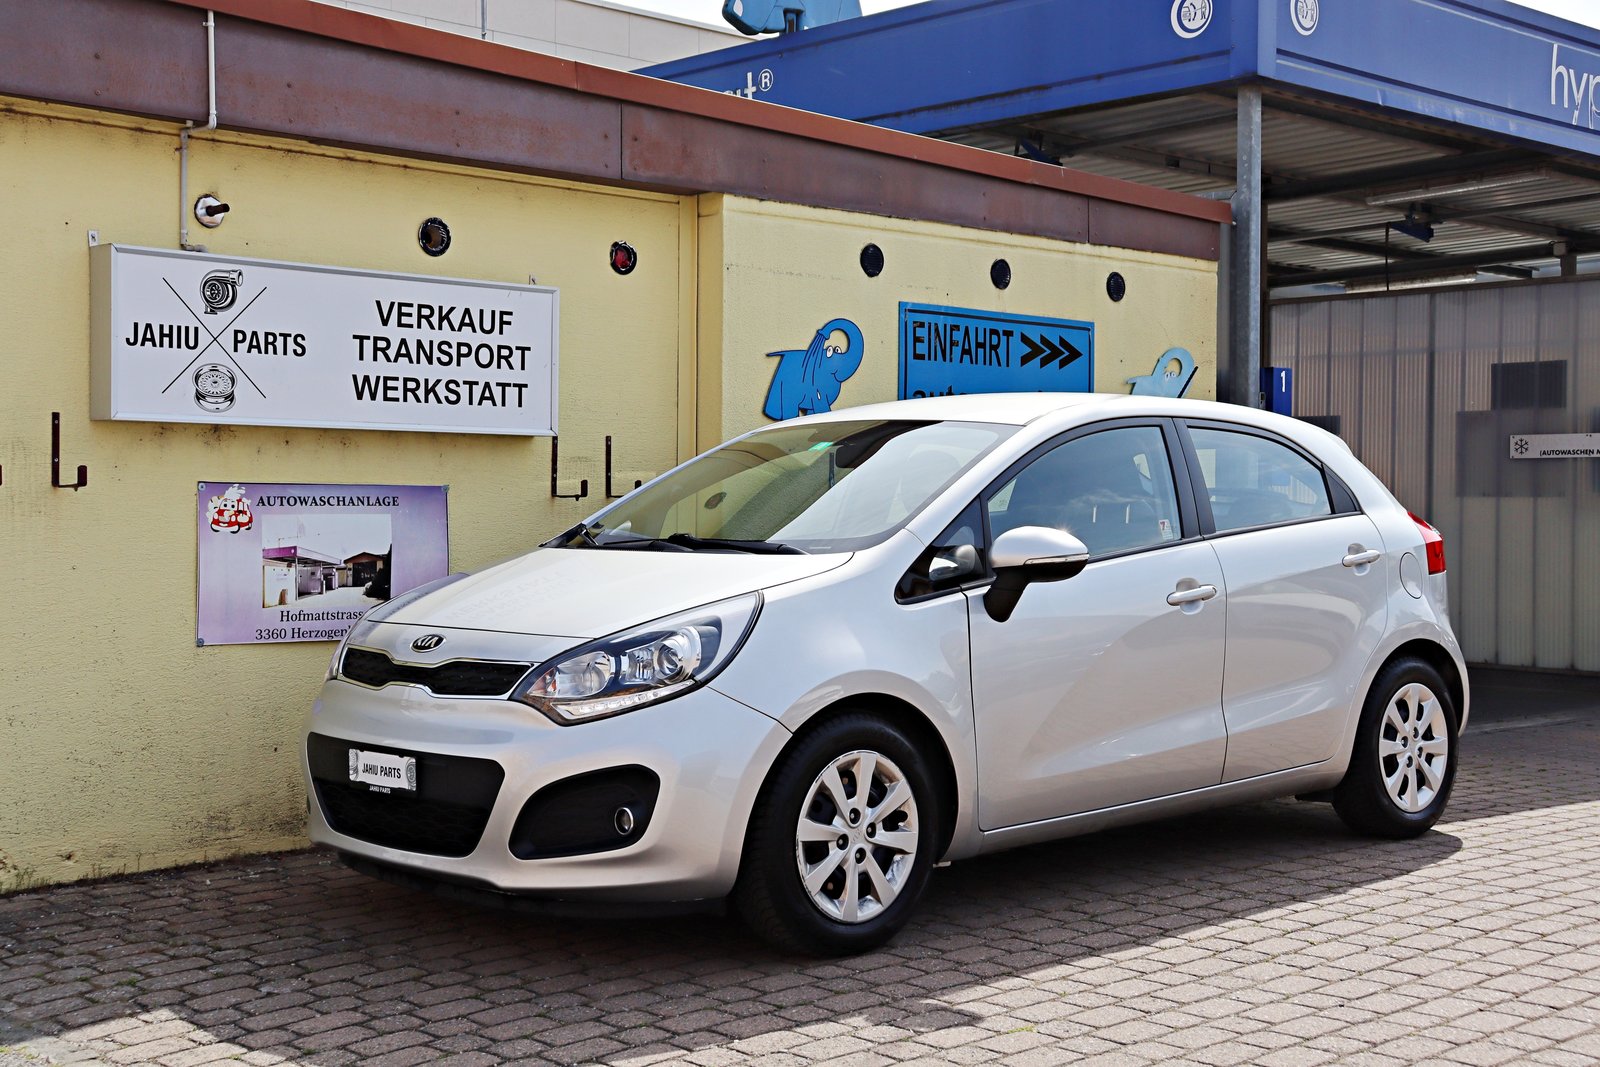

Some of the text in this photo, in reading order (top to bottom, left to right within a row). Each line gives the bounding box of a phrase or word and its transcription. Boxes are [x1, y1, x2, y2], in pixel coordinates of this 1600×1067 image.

[375, 299, 514, 336] VERKAUF
[125, 321, 307, 358] JAHIU PARTS
[352, 334, 532, 371] TRANSPORT
[912, 320, 1014, 368] EINFAHRT
[351, 373, 529, 408] WERKSTATT
[1280, 370, 1286, 393] 1
[255, 495, 400, 507] AUTOWASCHANLAGE
[255, 625, 351, 640] 3360 Herzogen
[413, 635, 440, 649] KIA
[362, 763, 401, 779] JAHIU PARTS
